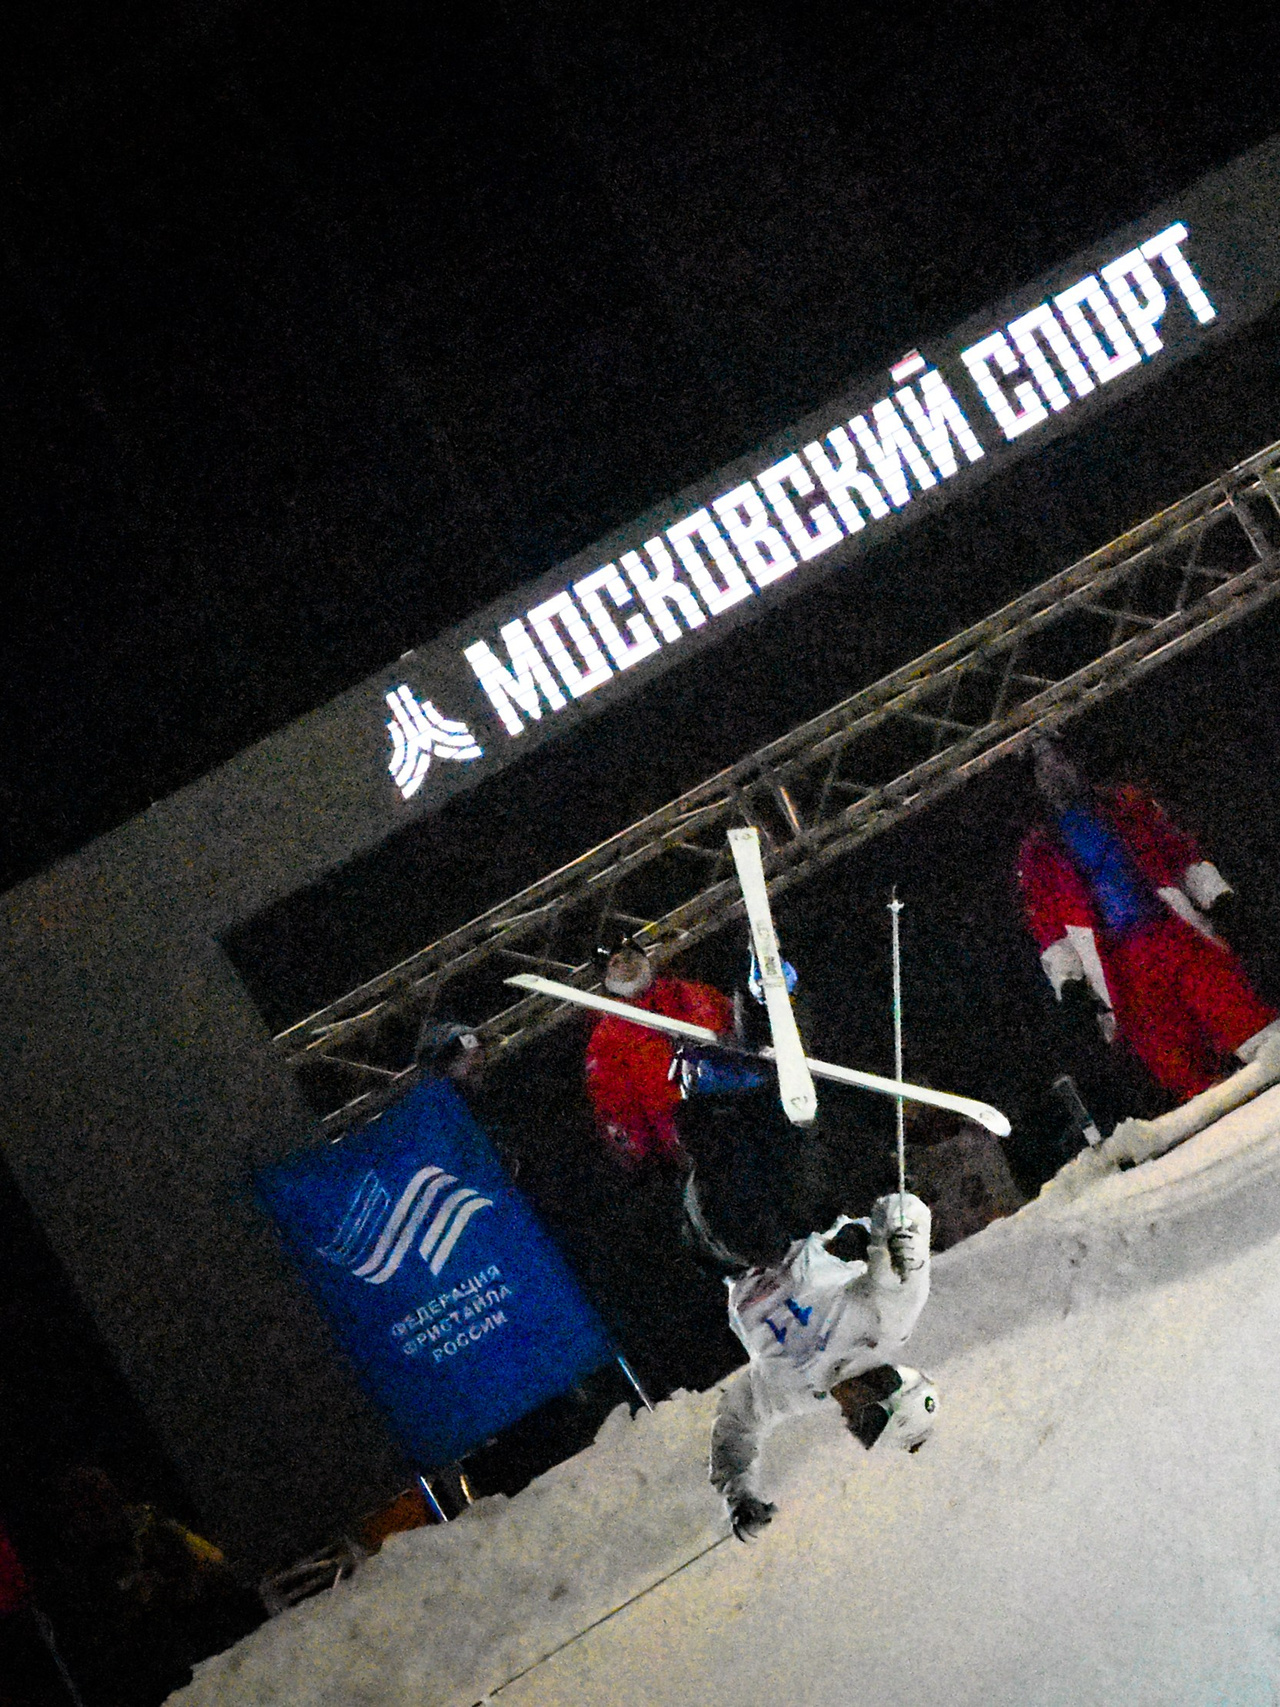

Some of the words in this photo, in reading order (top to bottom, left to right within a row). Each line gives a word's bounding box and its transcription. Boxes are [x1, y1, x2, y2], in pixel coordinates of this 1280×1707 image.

[462, 348, 986, 737] МОСКОВСКИЙ
[960, 222, 1216, 441] СПОРТ
[392, 1265, 501, 1337] ФЕДЕРАЦИЯ
[403, 1284, 512, 1357] ФРИСТАЙЛА
[432, 1311, 508, 1363] РОССИИ
